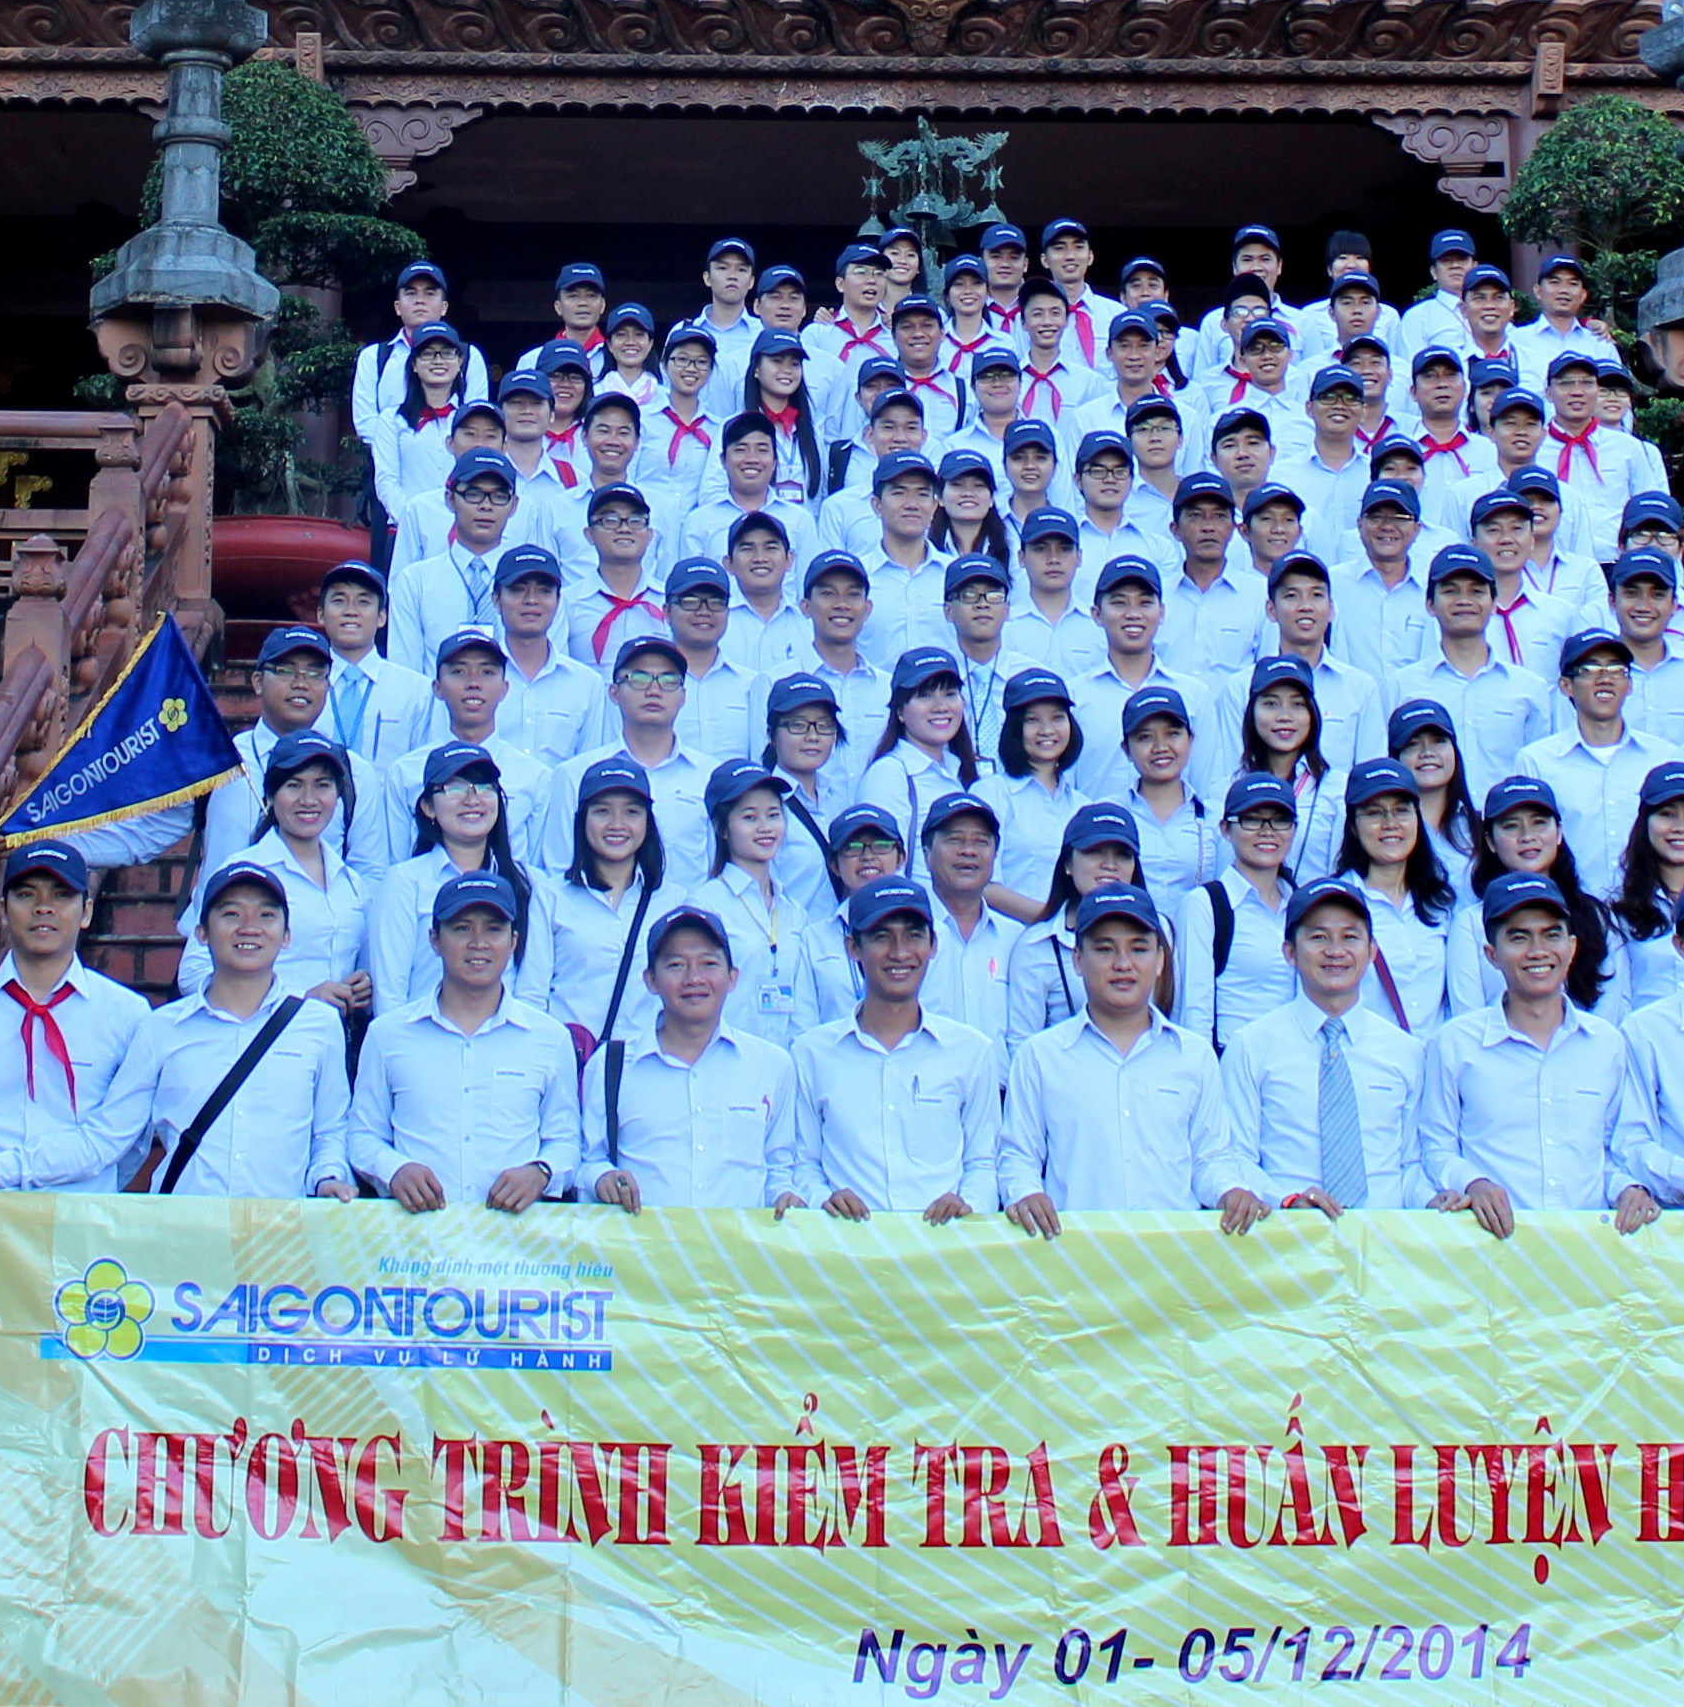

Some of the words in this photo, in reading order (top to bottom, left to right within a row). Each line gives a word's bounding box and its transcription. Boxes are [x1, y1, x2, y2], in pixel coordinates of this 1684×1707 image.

[26, 717, 161, 823] SAIGONTOURIST
[171, 1281, 614, 1341] SAIGONTOURIST
[510, 1349, 602, 1369] HÀNH
[83, 1415, 411, 1543] CHƯƠNG
[429, 1408, 674, 1547] TRÌNH
[693, 1392, 892, 1557] KIỂM
[911, 1437, 1065, 1549] TRA
[1087, 1442, 1148, 1551] &
[1165, 1392, 1371, 1551] HUẤN
[1389, 1415, 1618, 1585] LUYỆN
[851, 1627, 1034, 1700] Ngày
[1177, 1622, 1533, 1684] 05/12/2014
